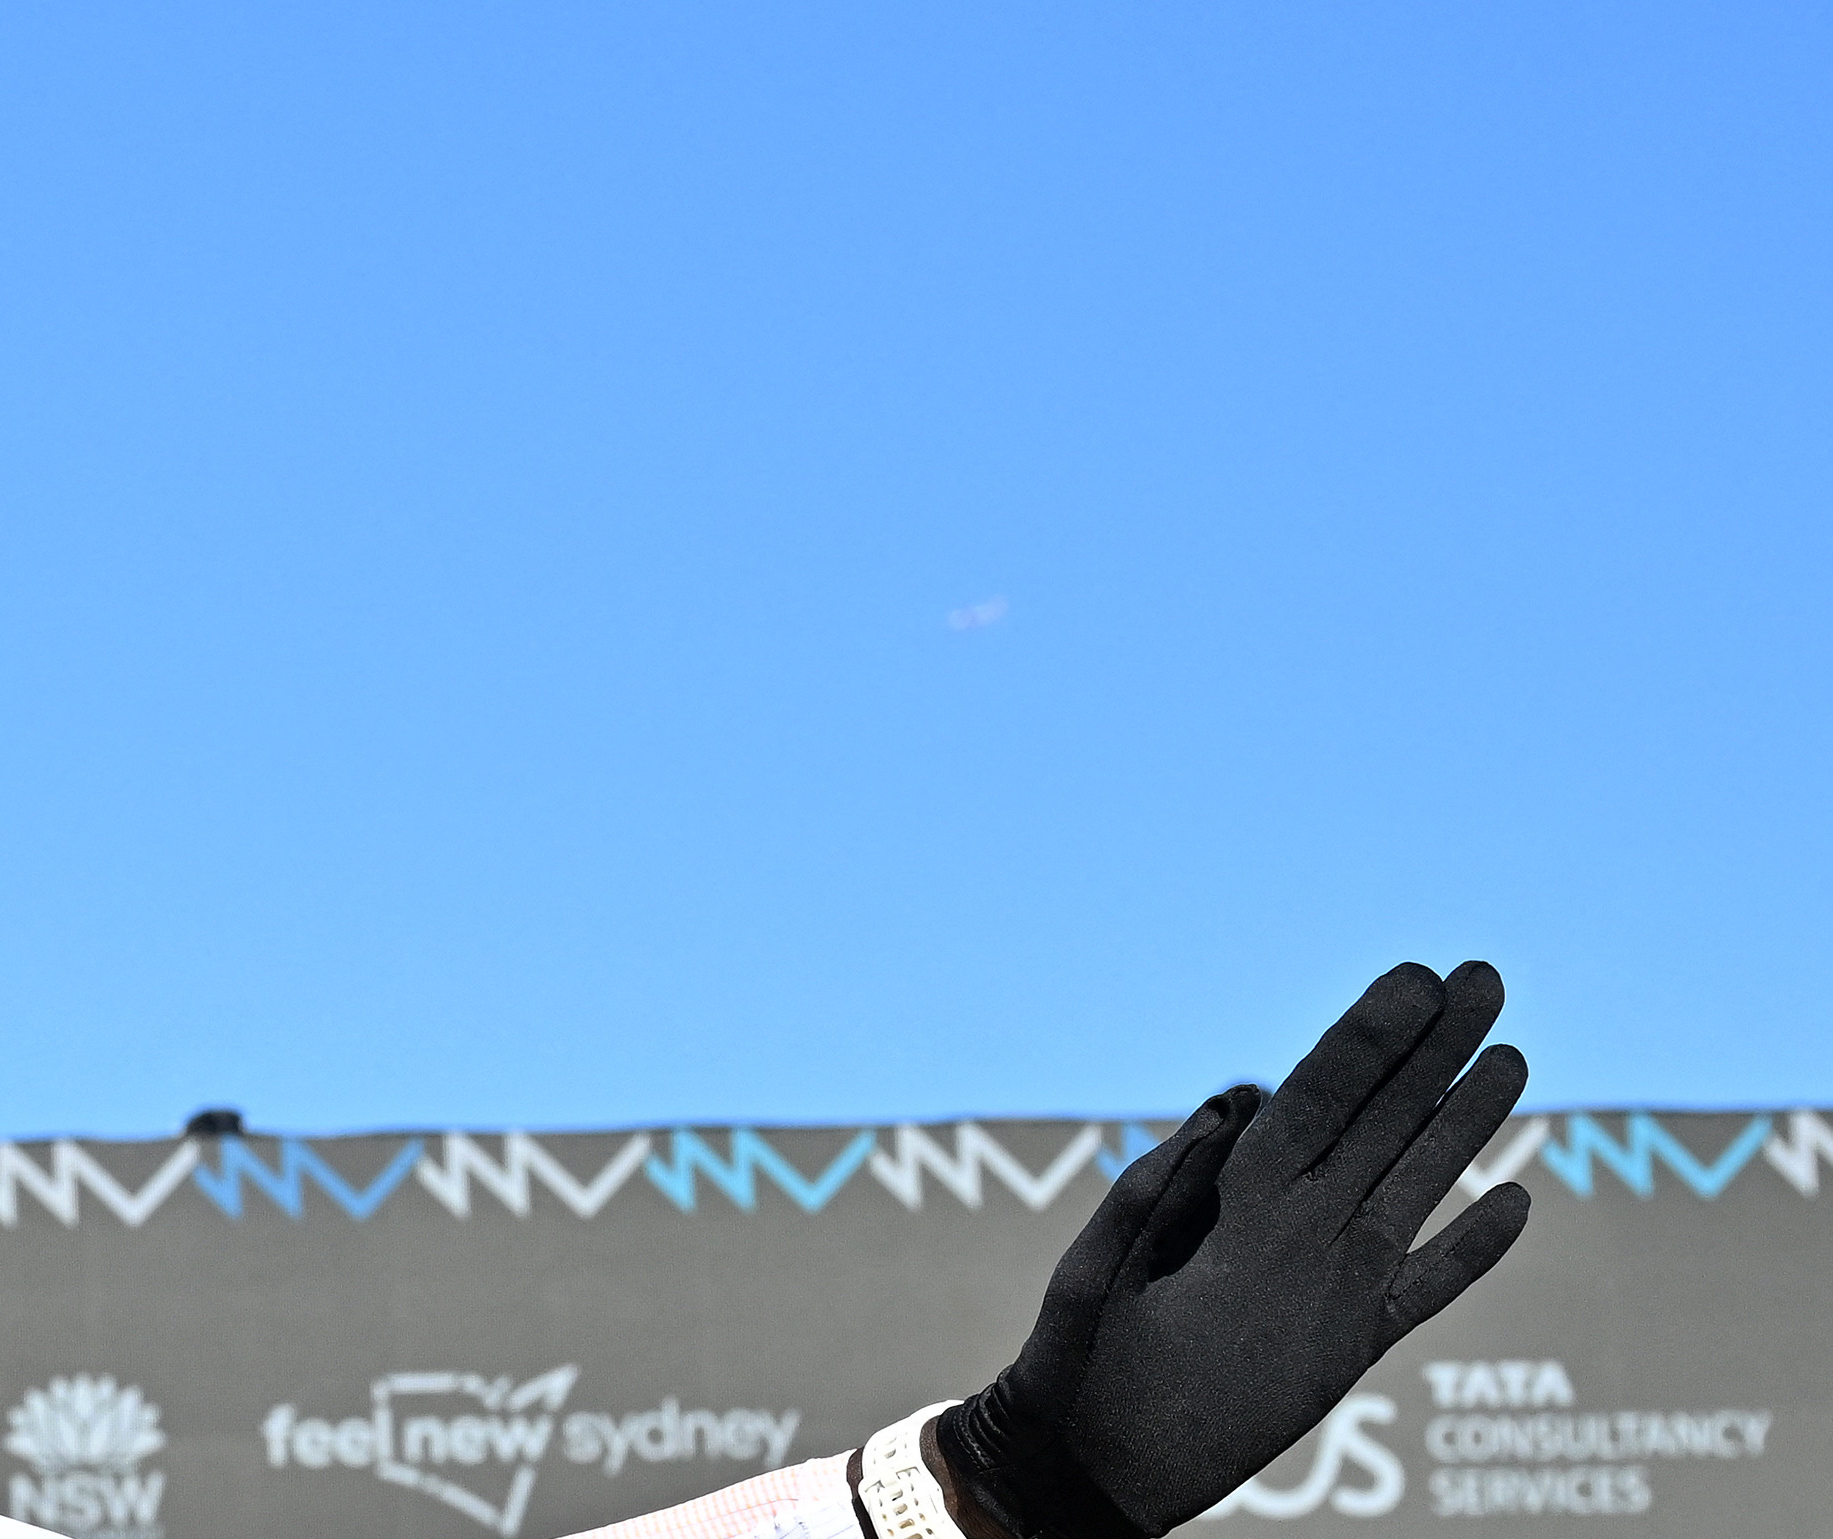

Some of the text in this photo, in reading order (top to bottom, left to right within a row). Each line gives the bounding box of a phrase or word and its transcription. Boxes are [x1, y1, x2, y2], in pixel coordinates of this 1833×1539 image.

[1424, 1361, 1573, 1407] TATA
[264, 1396, 799, 1477] feel new sydney
[1425, 1409, 1773, 1461] CONSULTANCY
[9, 1471, 165, 1531] NSW
[1430, 1465, 1652, 1516] SERVICES
